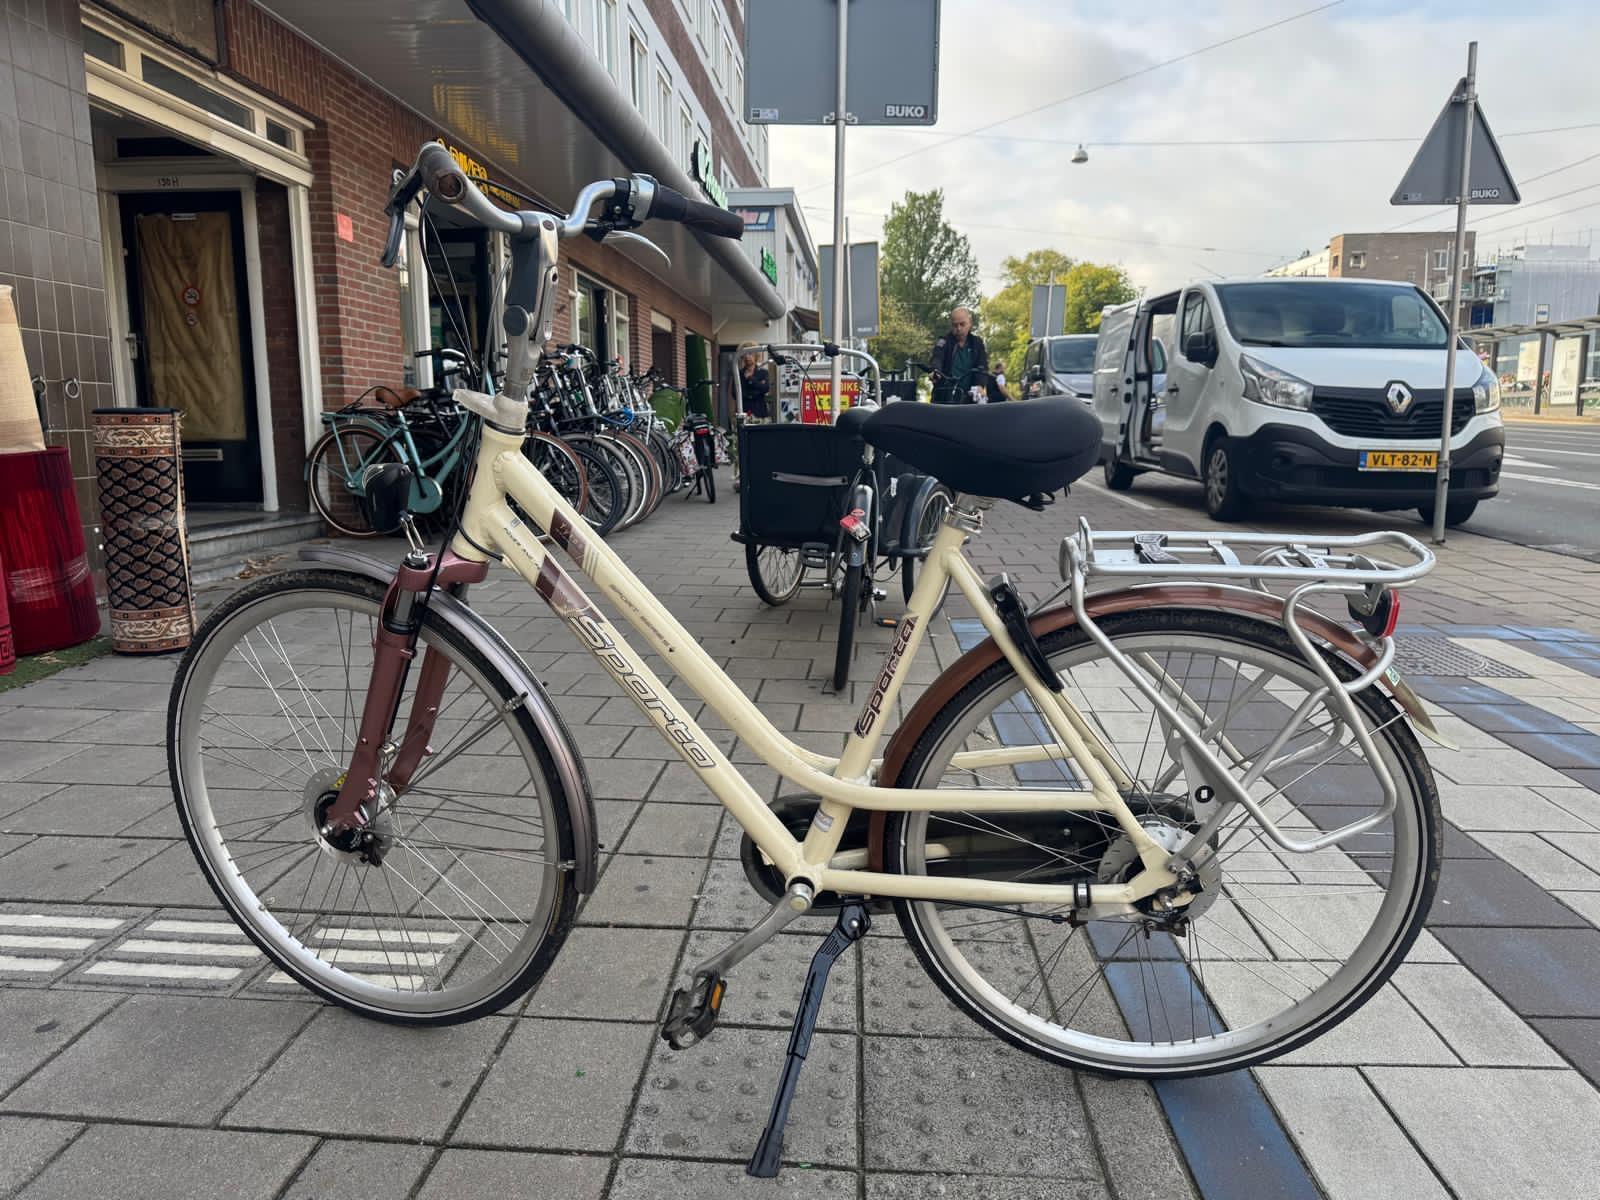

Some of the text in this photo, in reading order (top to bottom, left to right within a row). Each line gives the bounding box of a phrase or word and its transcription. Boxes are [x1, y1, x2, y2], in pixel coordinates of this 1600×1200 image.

[885, 105, 925, 117] BUKO
[1471, 189, 1499, 199] BUKO
[804, 382, 831, 392] RENT
[567, 614, 717, 768] Sparta
